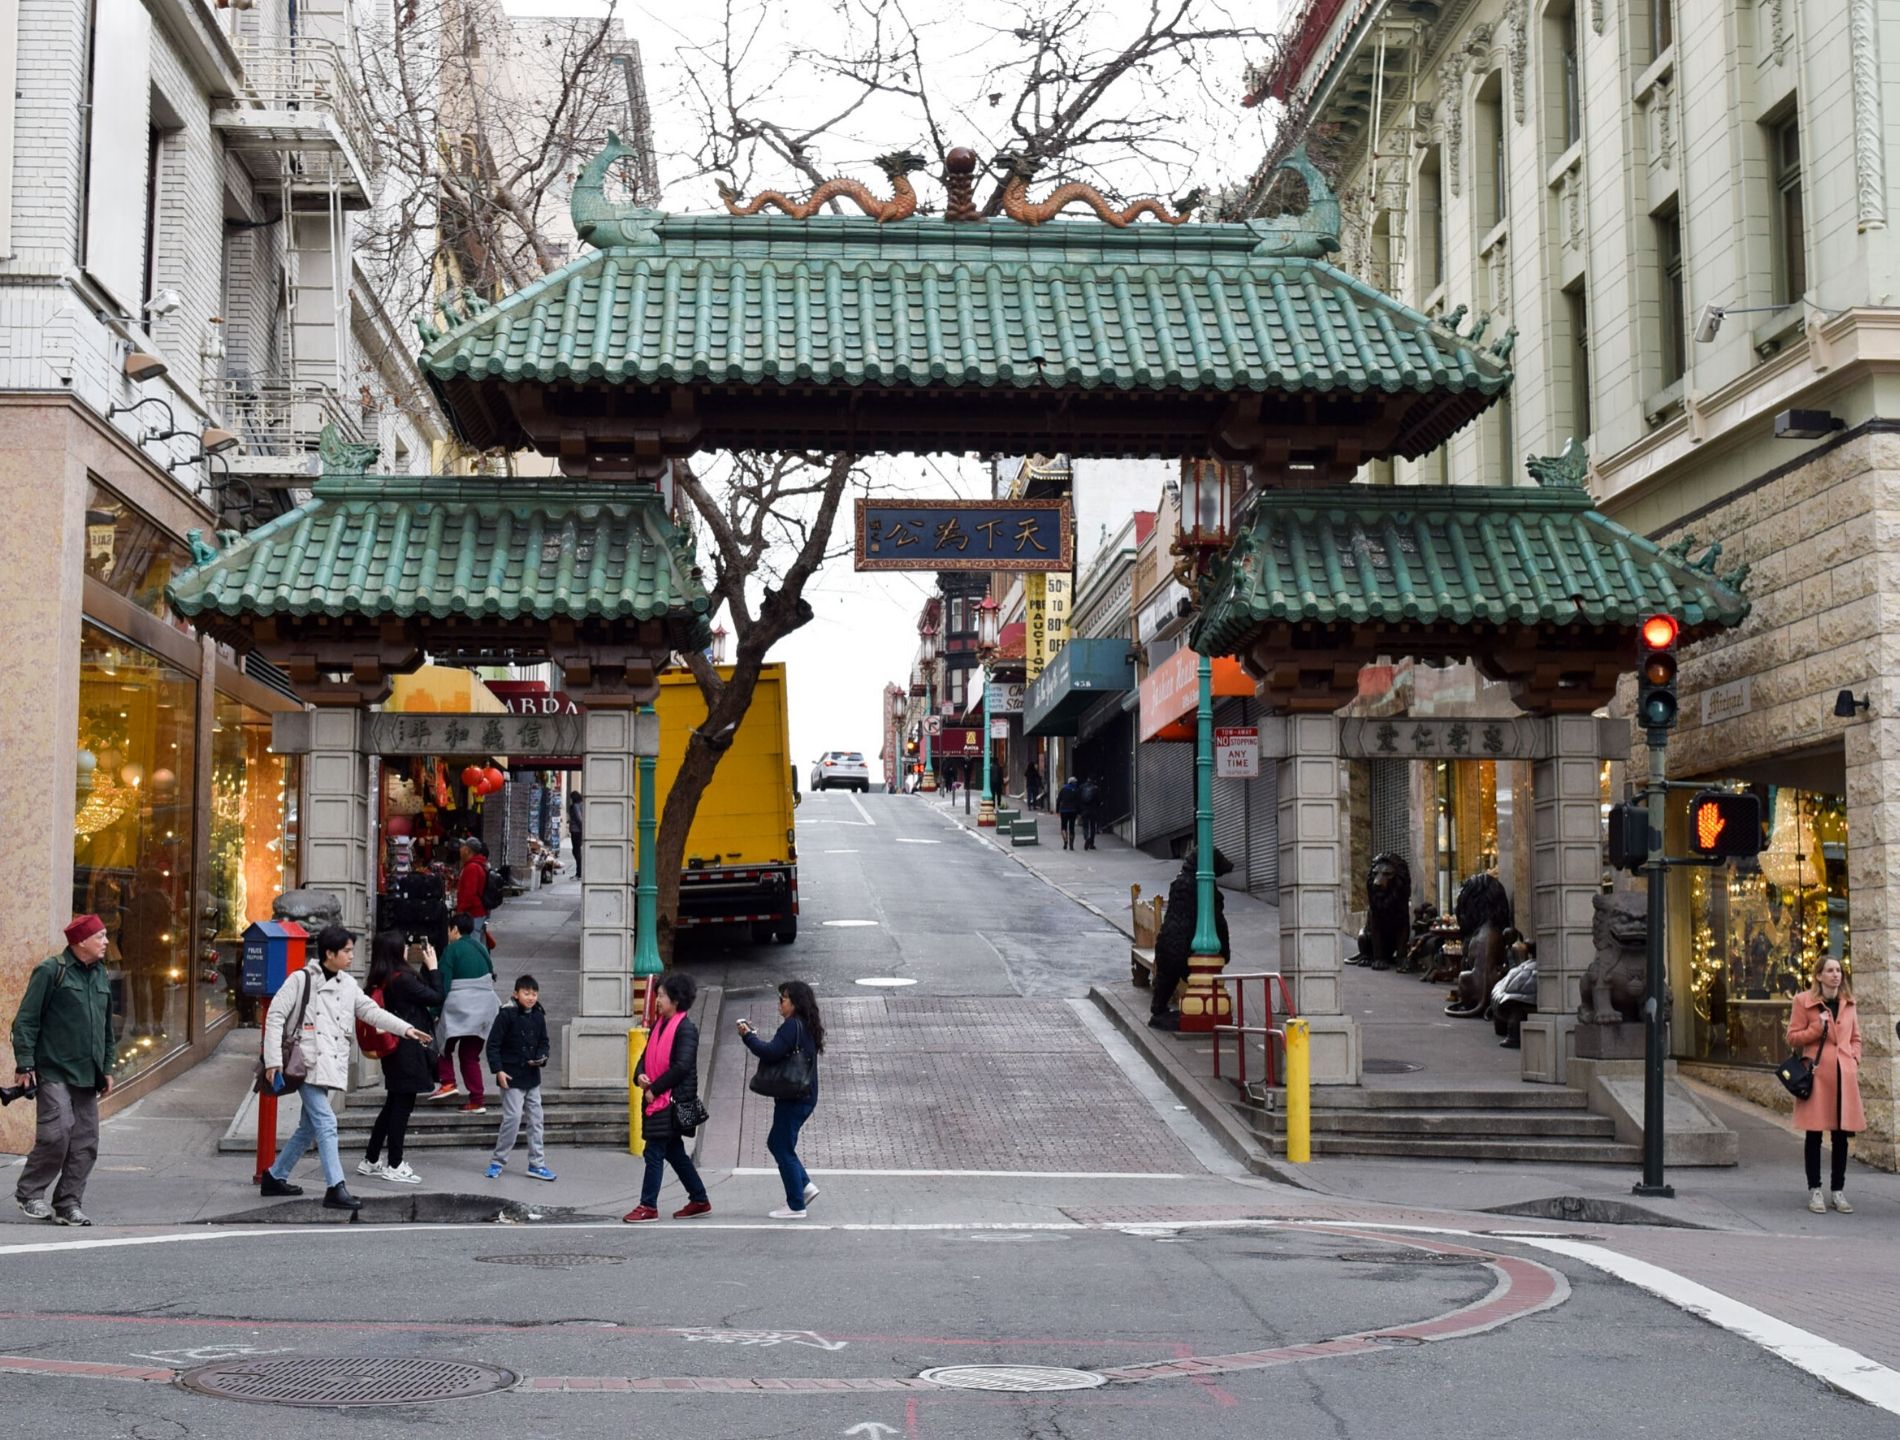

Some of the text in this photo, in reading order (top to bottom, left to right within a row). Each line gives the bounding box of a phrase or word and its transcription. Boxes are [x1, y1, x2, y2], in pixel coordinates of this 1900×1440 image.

[885, 517, 1048, 551] 天下為公
[1052, 600, 1063, 611] TO
[1216, 736, 1258, 746] NO STOPPING
[1228, 750, 1247, 758] ANY
[1227, 759, 1249, 767] TIME
